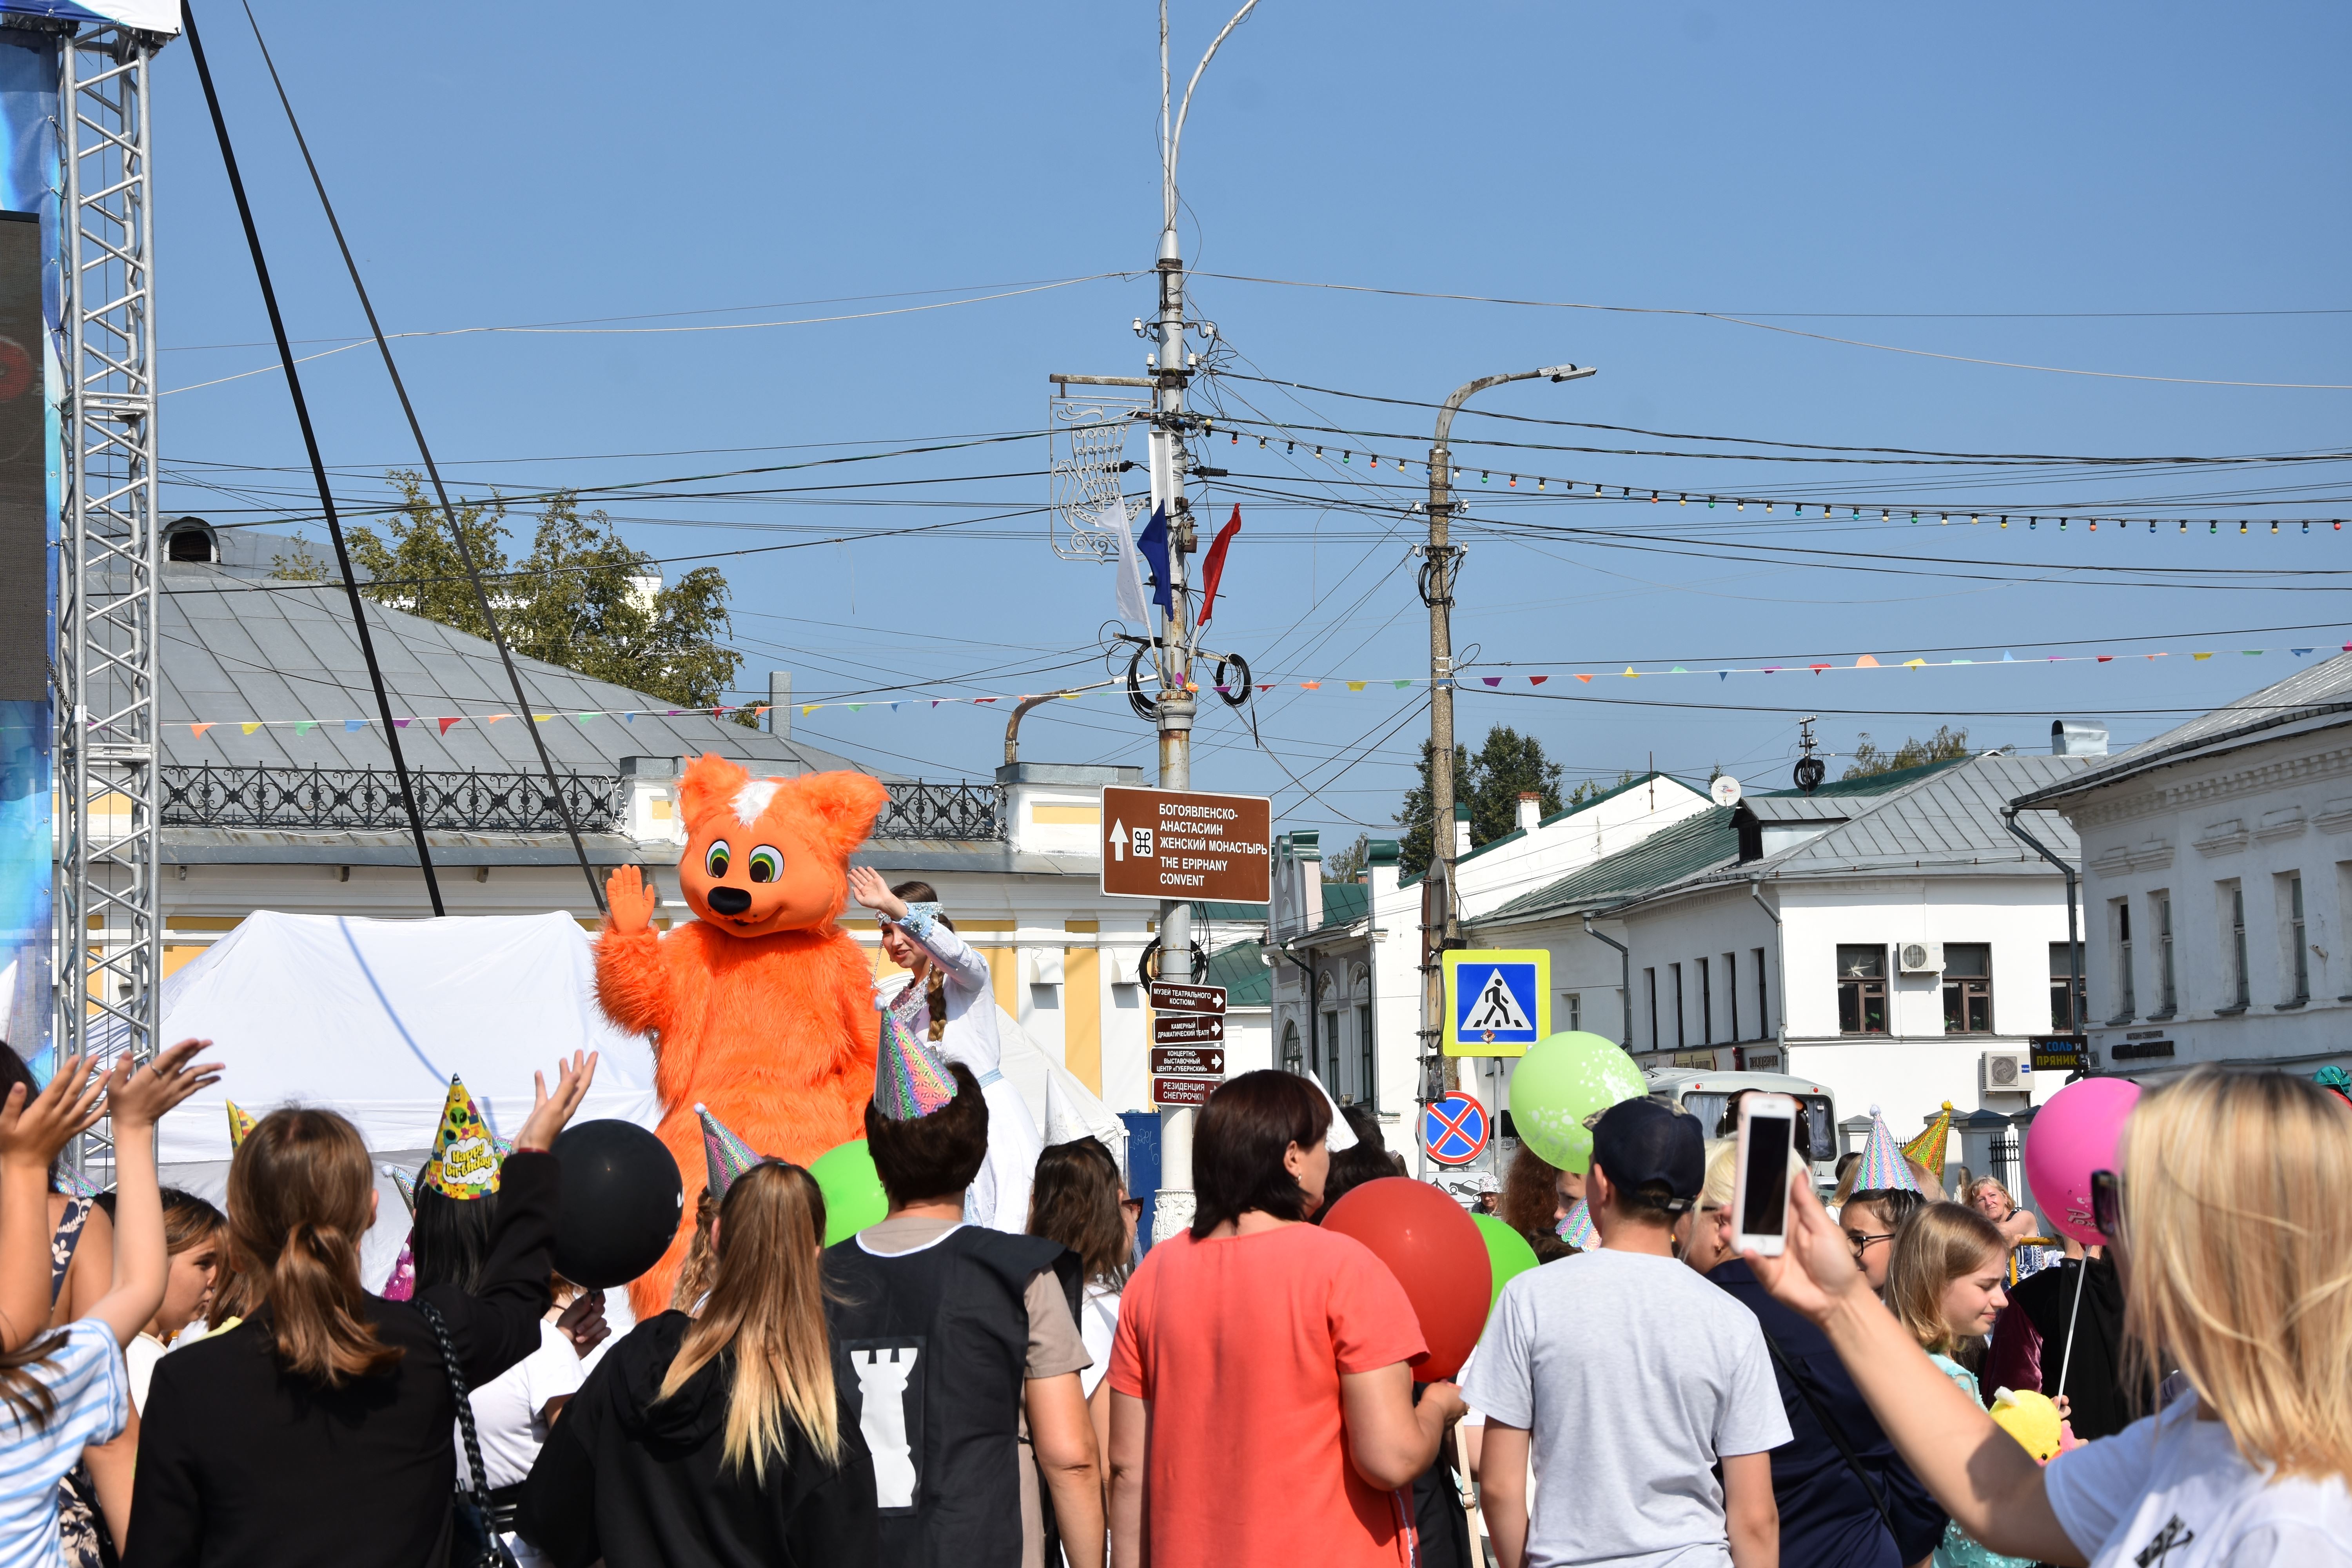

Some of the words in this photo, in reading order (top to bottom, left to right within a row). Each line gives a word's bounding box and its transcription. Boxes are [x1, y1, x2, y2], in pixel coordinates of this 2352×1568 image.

[1159, 803, 1238, 820] БОГОЯВЛЕНСКО-
[1160, 820, 1223, 835] АНАСТАСИИН
[1160, 837, 1206, 851] ЖЕНСКИЙ
[1209, 840, 1267, 855] МОНАСТЫРЬ
[1160, 856, 1179, 868] THE
[1182, 858, 1228, 871] EPIPHANY
[1160, 873, 1205, 886] CONVENT
[1171, 990, 1211, 999] ТЕАТРАЛЬНОГО
[1169, 998, 1195, 1006] КОСТЮМА
[1158, 1029, 1195, 1039] ДРАМАТИЧЕСКИЙ
[2046, 1041, 2073, 1052] СОЛЬ
[2036, 1054, 2078, 1065] ПРЯНИК
[1163, 1082, 1205, 1092] РЕЗИДЕНЦИЯ
[1163, 1091, 1204, 1101] СНЕГУРОЧКИ
[452, 1142, 485, 1163] Happy
[446, 1154, 492, 1178] Birthday!
